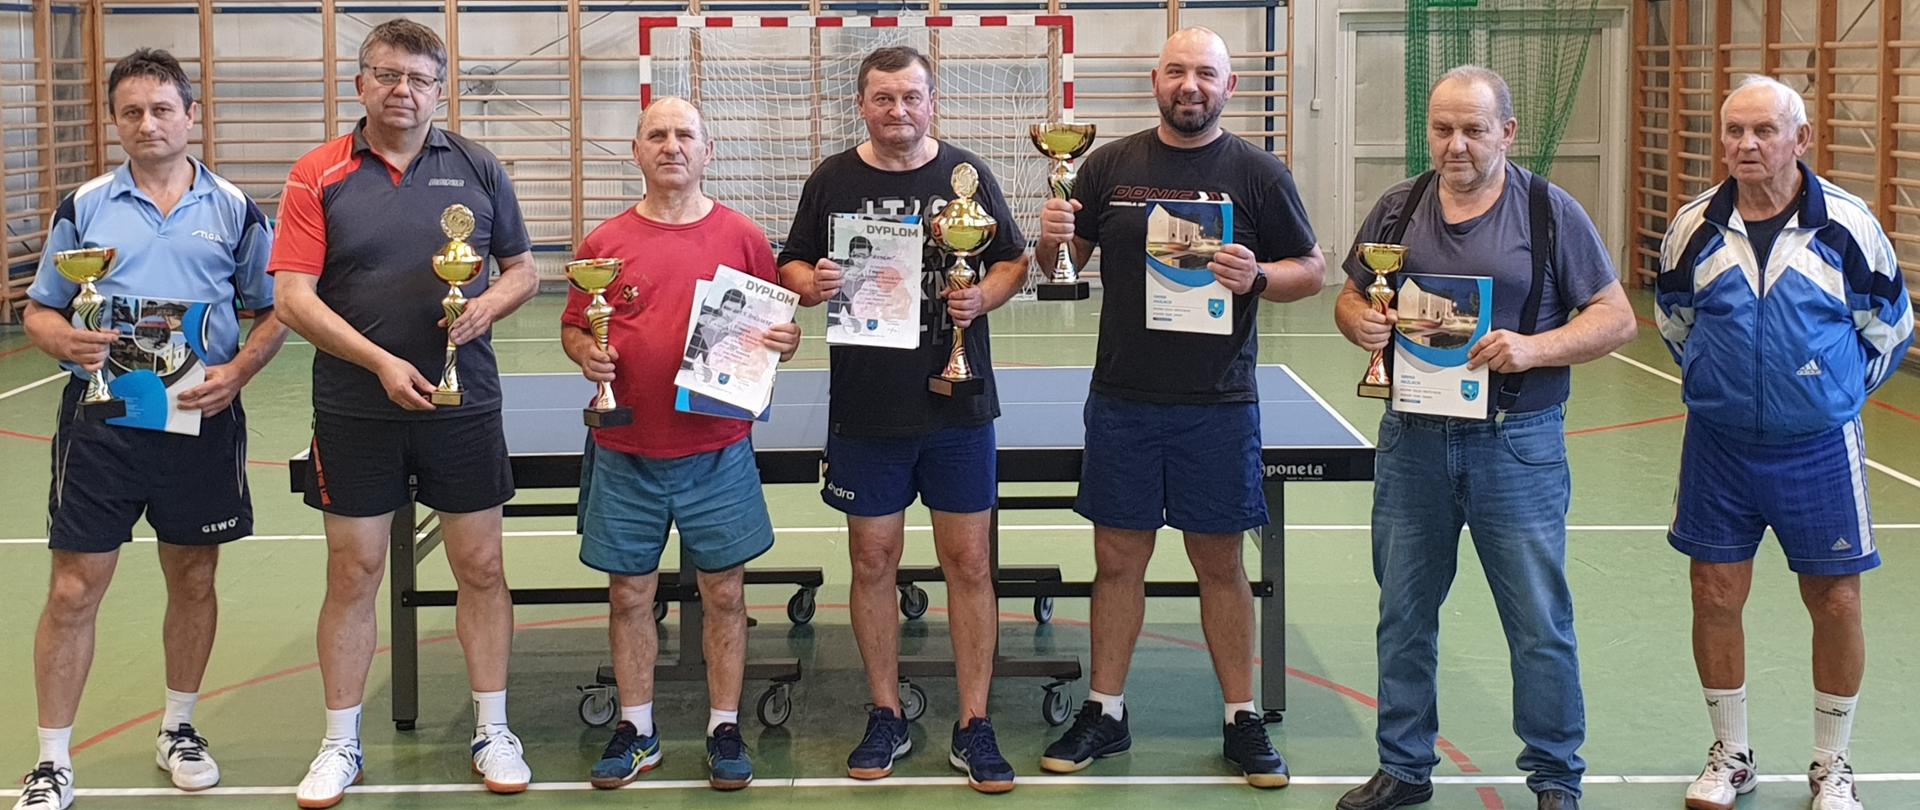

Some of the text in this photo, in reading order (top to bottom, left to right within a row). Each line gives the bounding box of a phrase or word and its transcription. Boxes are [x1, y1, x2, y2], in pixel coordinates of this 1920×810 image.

[1112, 185, 1194, 200] DONIC
[866, 225, 919, 238] DYPLOM
[745, 280, 796, 306] DYPLOM
[1260, 462, 1323, 477] poneta
[202, 518, 236, 533] GEWO
